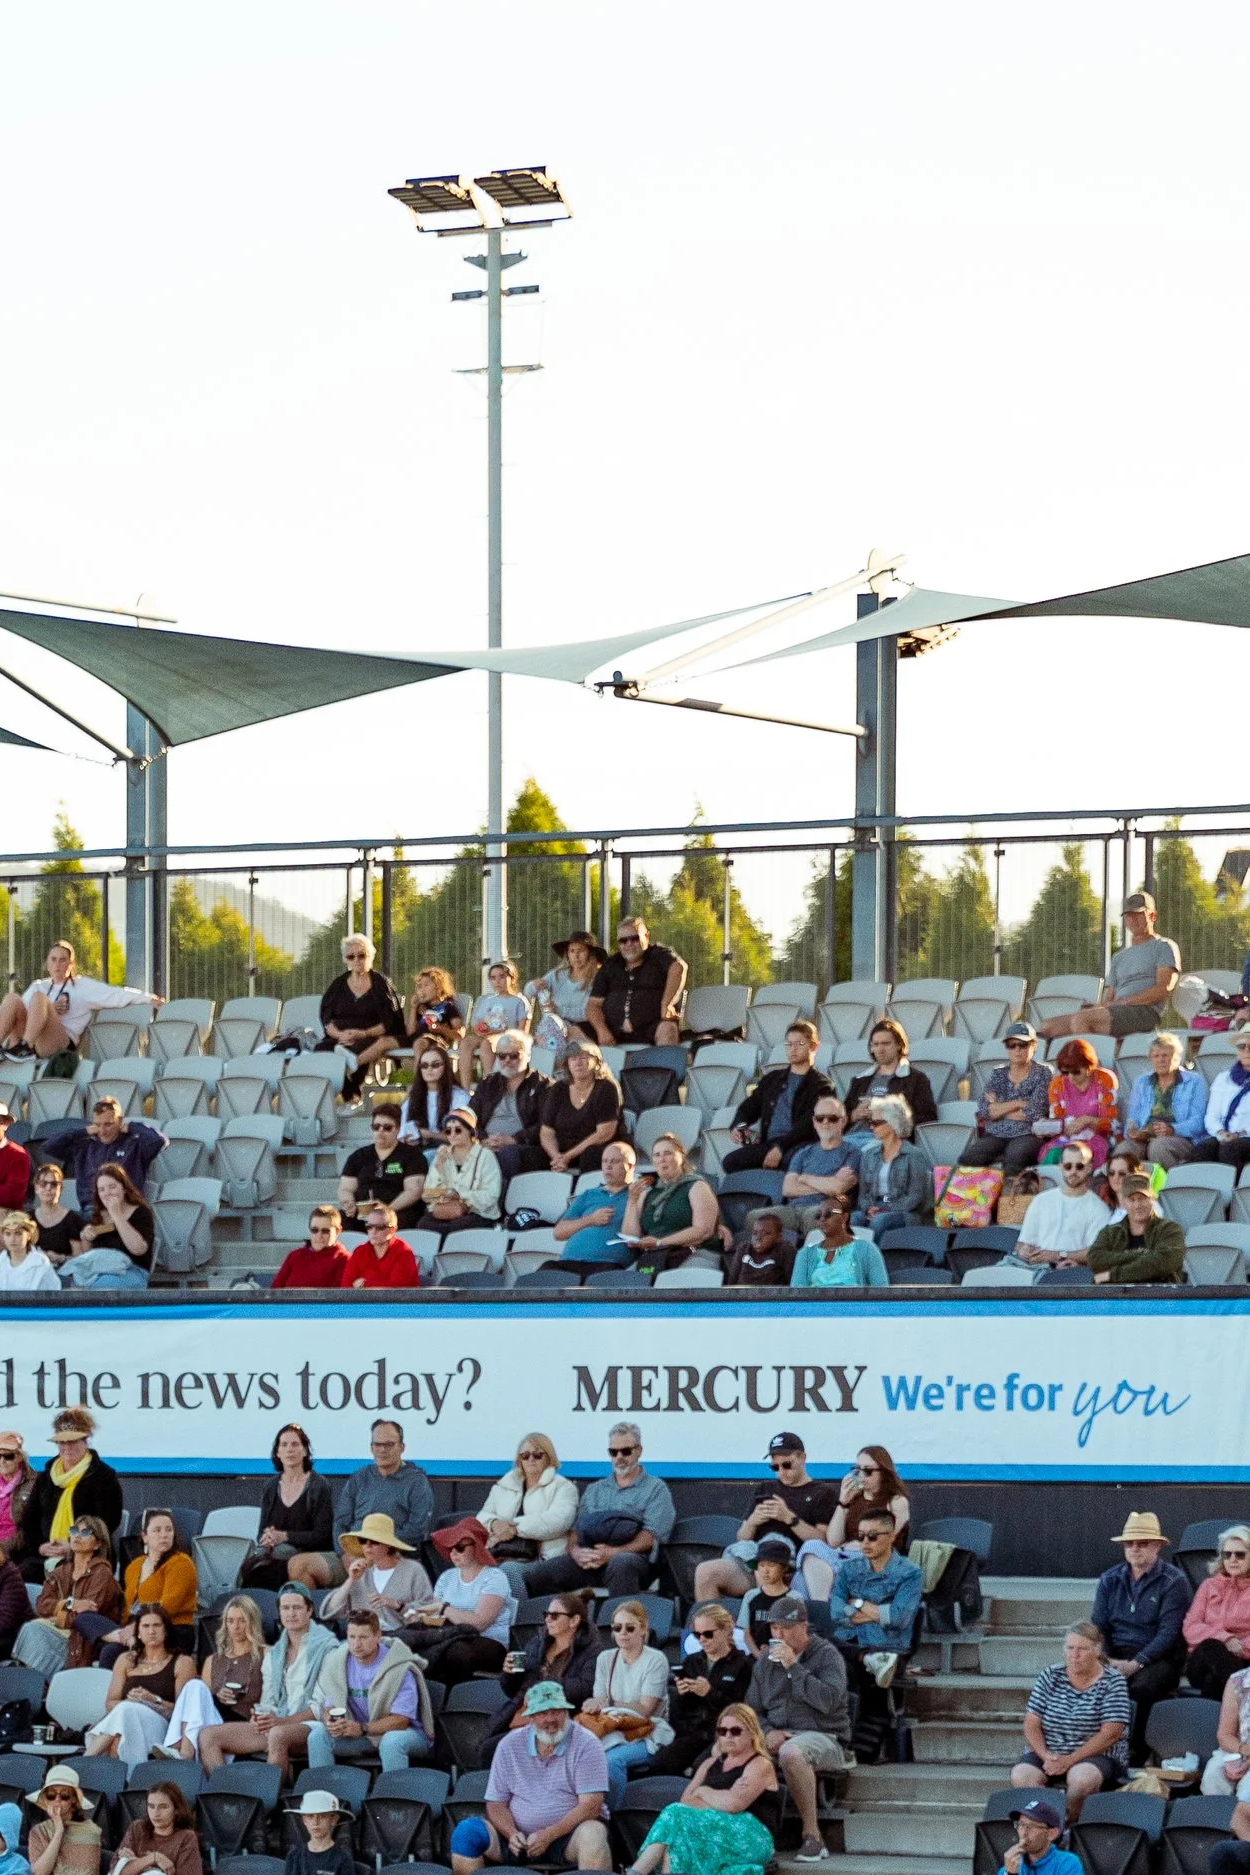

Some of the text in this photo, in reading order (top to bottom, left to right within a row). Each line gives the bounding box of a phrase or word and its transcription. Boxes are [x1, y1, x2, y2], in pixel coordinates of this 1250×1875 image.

[31, 1357, 121, 1410] the
[136, 1371, 281, 1411] news
[295, 1357, 481, 1427] today?
[571, 1364, 1193, 1450] MERCURY We're for you
